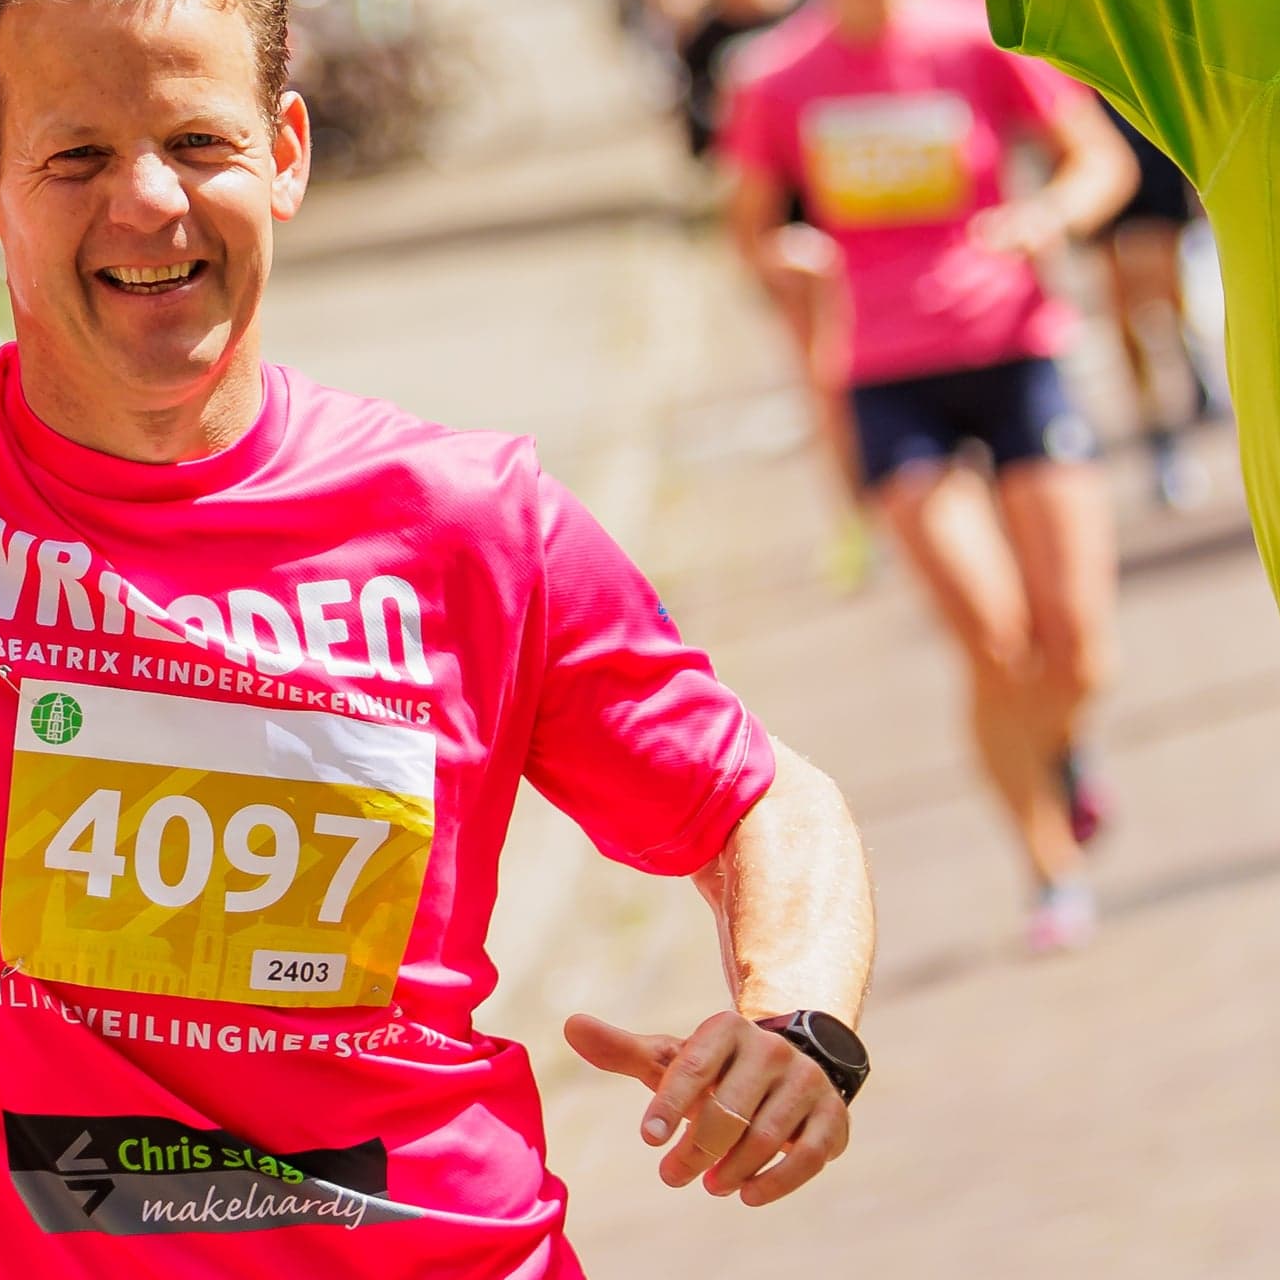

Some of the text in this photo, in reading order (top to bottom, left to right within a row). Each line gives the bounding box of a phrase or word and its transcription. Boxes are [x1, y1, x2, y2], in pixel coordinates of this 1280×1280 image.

[43, 787, 392, 924] 4097
[267, 959, 330, 984] 2403
[118, 1136, 212, 1171] Chris
